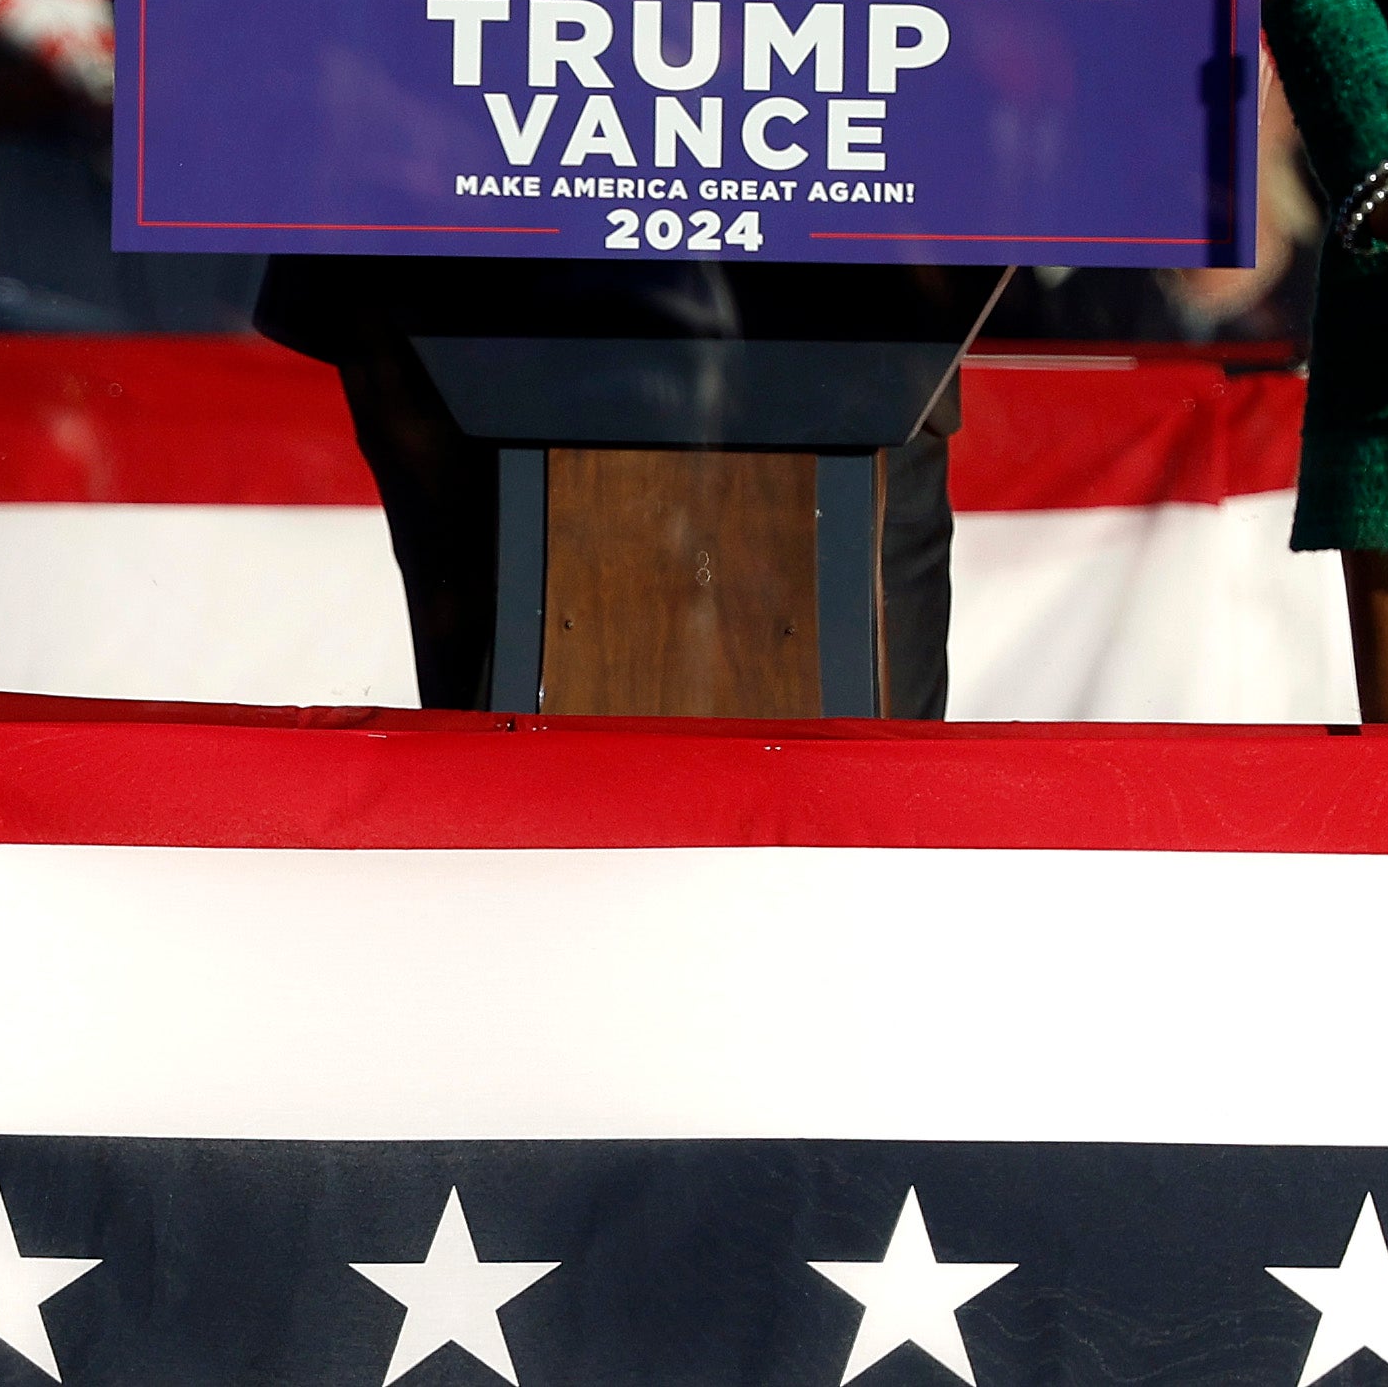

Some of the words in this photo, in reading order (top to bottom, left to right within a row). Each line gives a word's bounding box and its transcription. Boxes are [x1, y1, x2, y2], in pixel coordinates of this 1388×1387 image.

[484, 94, 887, 171] VANCE
[455, 175, 541, 197] MAKE
[550, 177, 689, 200] AMERICA
[698, 179, 798, 201] GREAT
[807, 181, 916, 204] AGAIN!
[605, 209, 764, 251] 2024
